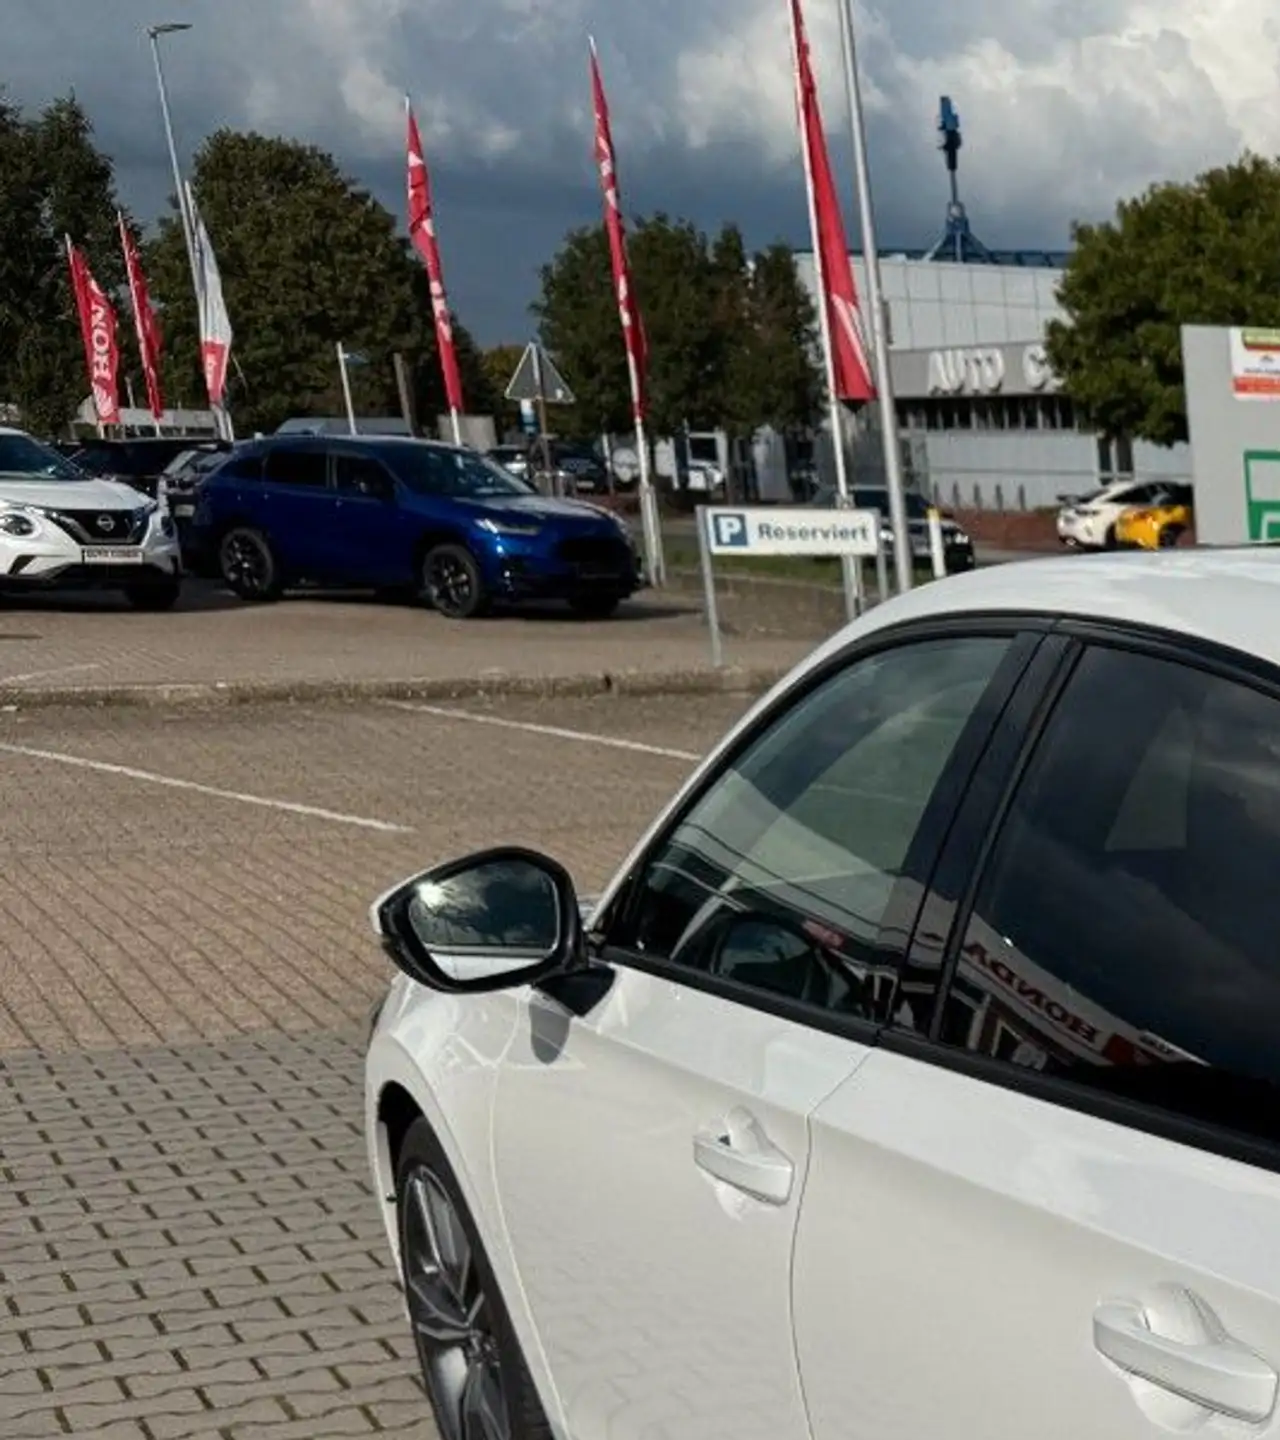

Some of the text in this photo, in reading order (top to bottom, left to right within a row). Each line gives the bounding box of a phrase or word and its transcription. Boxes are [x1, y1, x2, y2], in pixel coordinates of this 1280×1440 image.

[928, 349, 1004, 394] AUTO
[719, 516, 869, 544] P Reserviert
